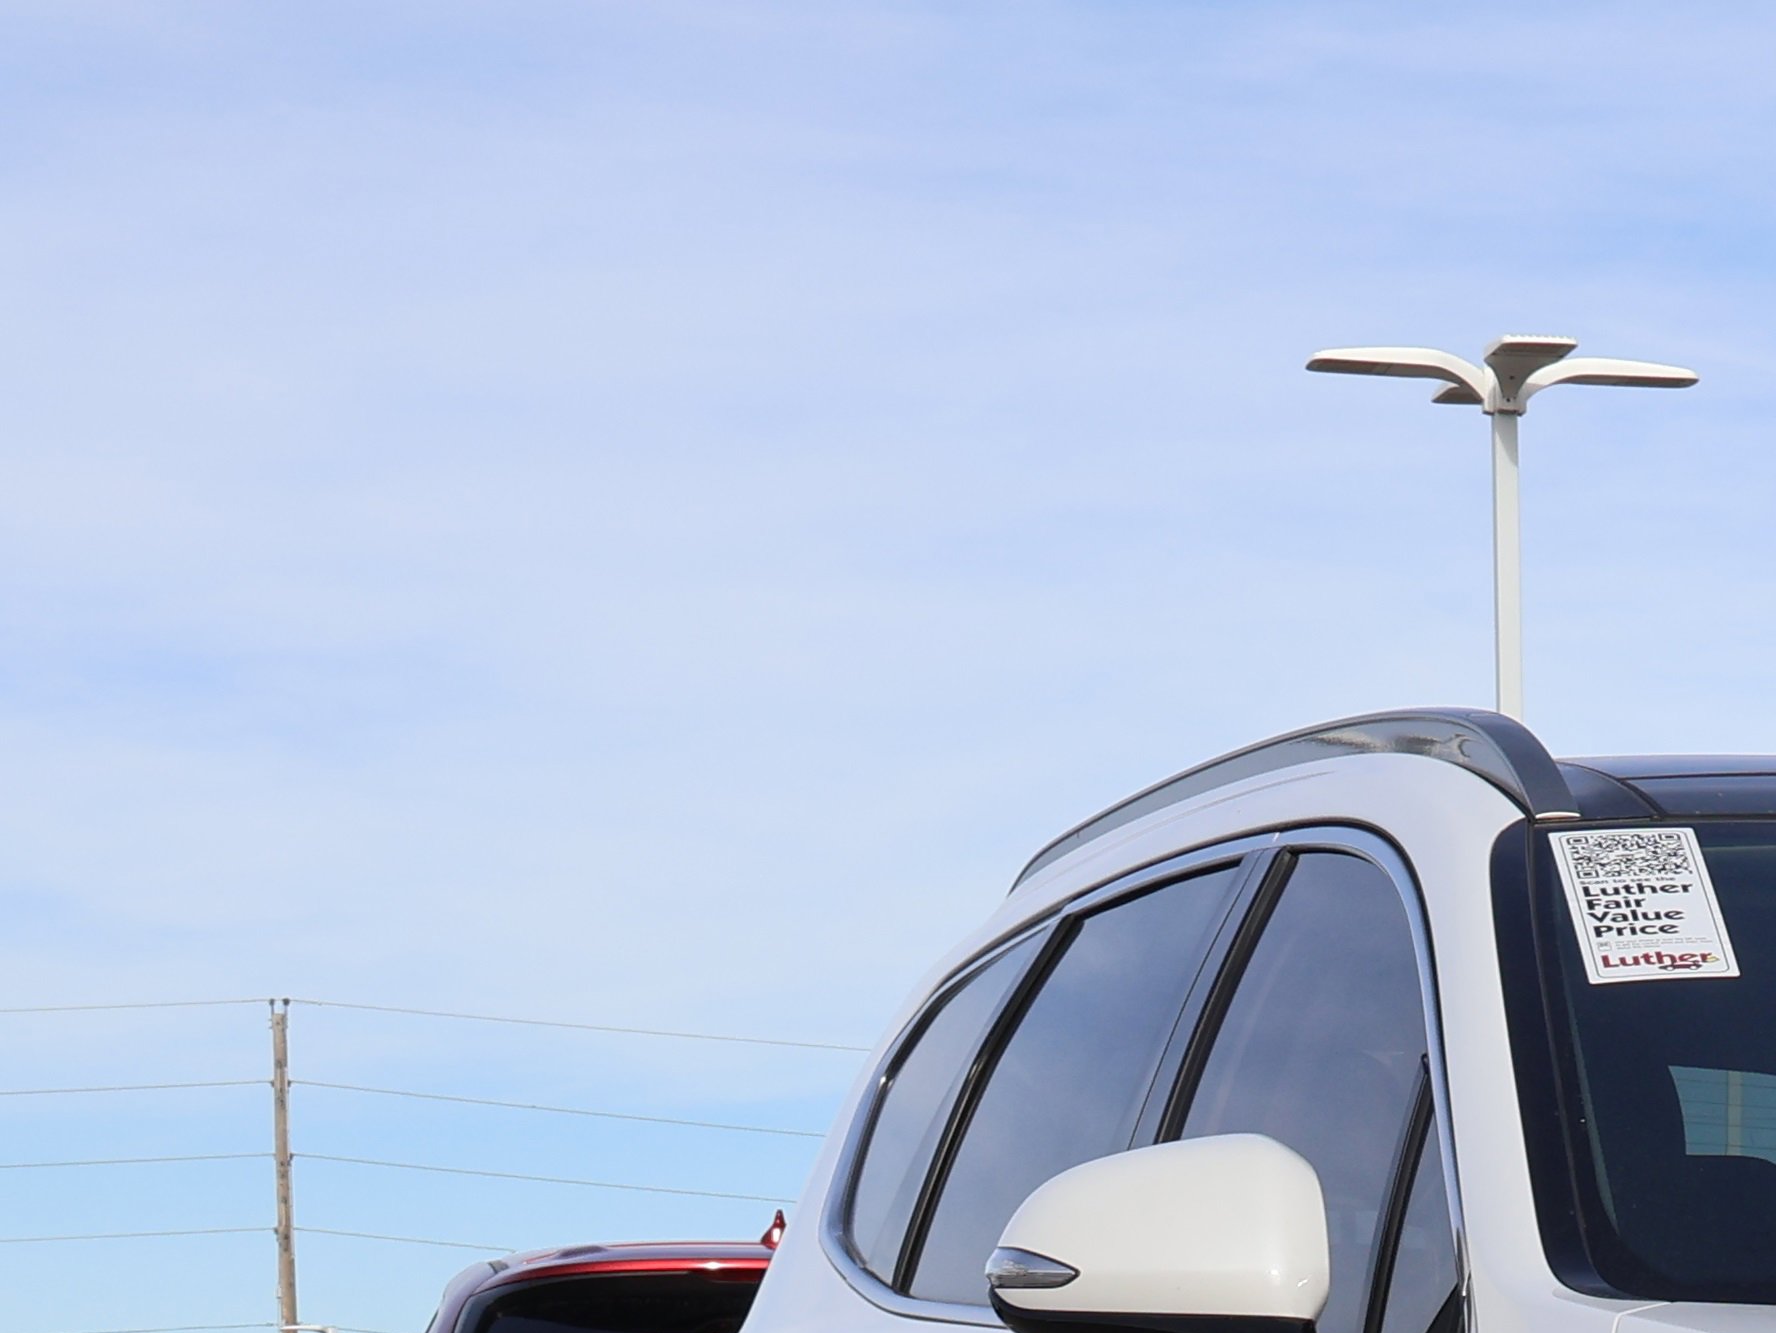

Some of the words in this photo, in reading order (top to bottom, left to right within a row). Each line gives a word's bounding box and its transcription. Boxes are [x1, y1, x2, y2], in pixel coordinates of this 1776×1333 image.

[1582, 883, 1693, 897] Luther
[1585, 896, 1646, 911] Fair
[1586, 909, 1685, 923] Value
[1593, 923, 1680, 938] Price
[1601, 951, 1713, 968] Luther
